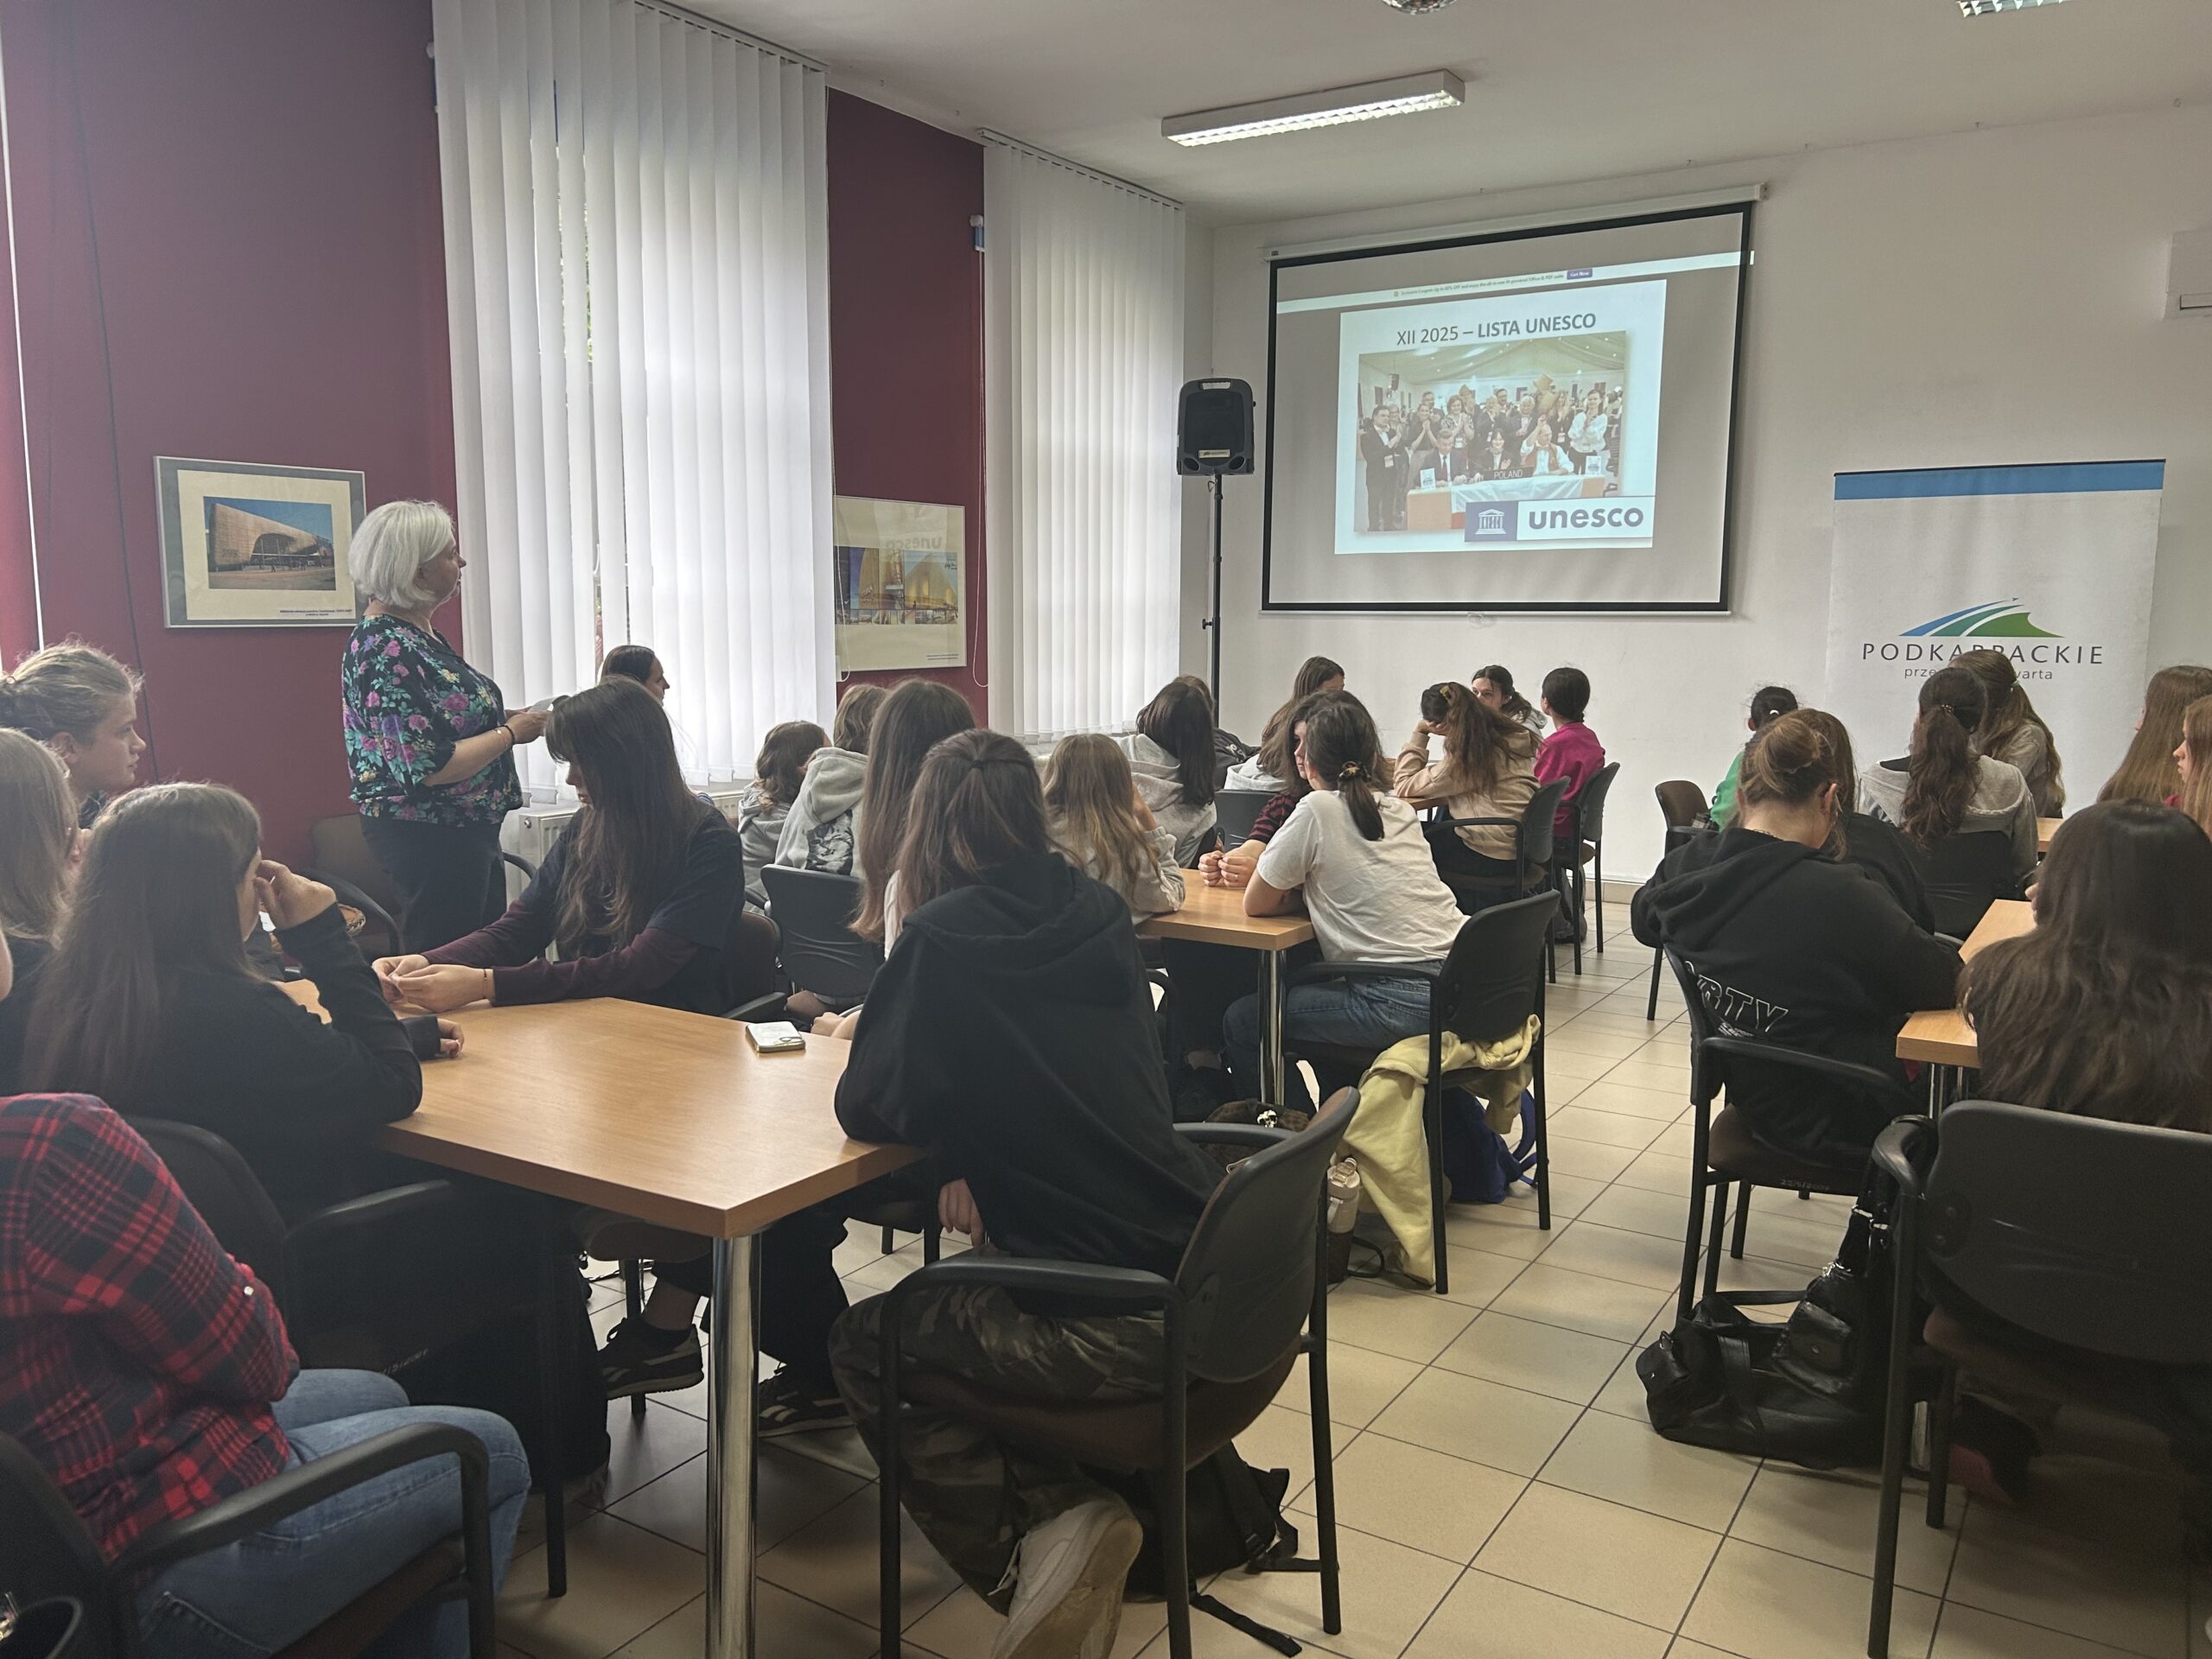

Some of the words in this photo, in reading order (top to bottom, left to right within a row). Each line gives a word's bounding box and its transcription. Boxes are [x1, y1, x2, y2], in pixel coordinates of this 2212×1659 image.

[1396, 330, 1416, 346] XII
[1421, 326, 1459, 343] 2025
[1478, 320, 1521, 338] LISTA
[1525, 312, 1597, 334] UNESCO
[1493, 468, 1523, 479] POLAND
[1529, 507, 1644, 530] unesco
